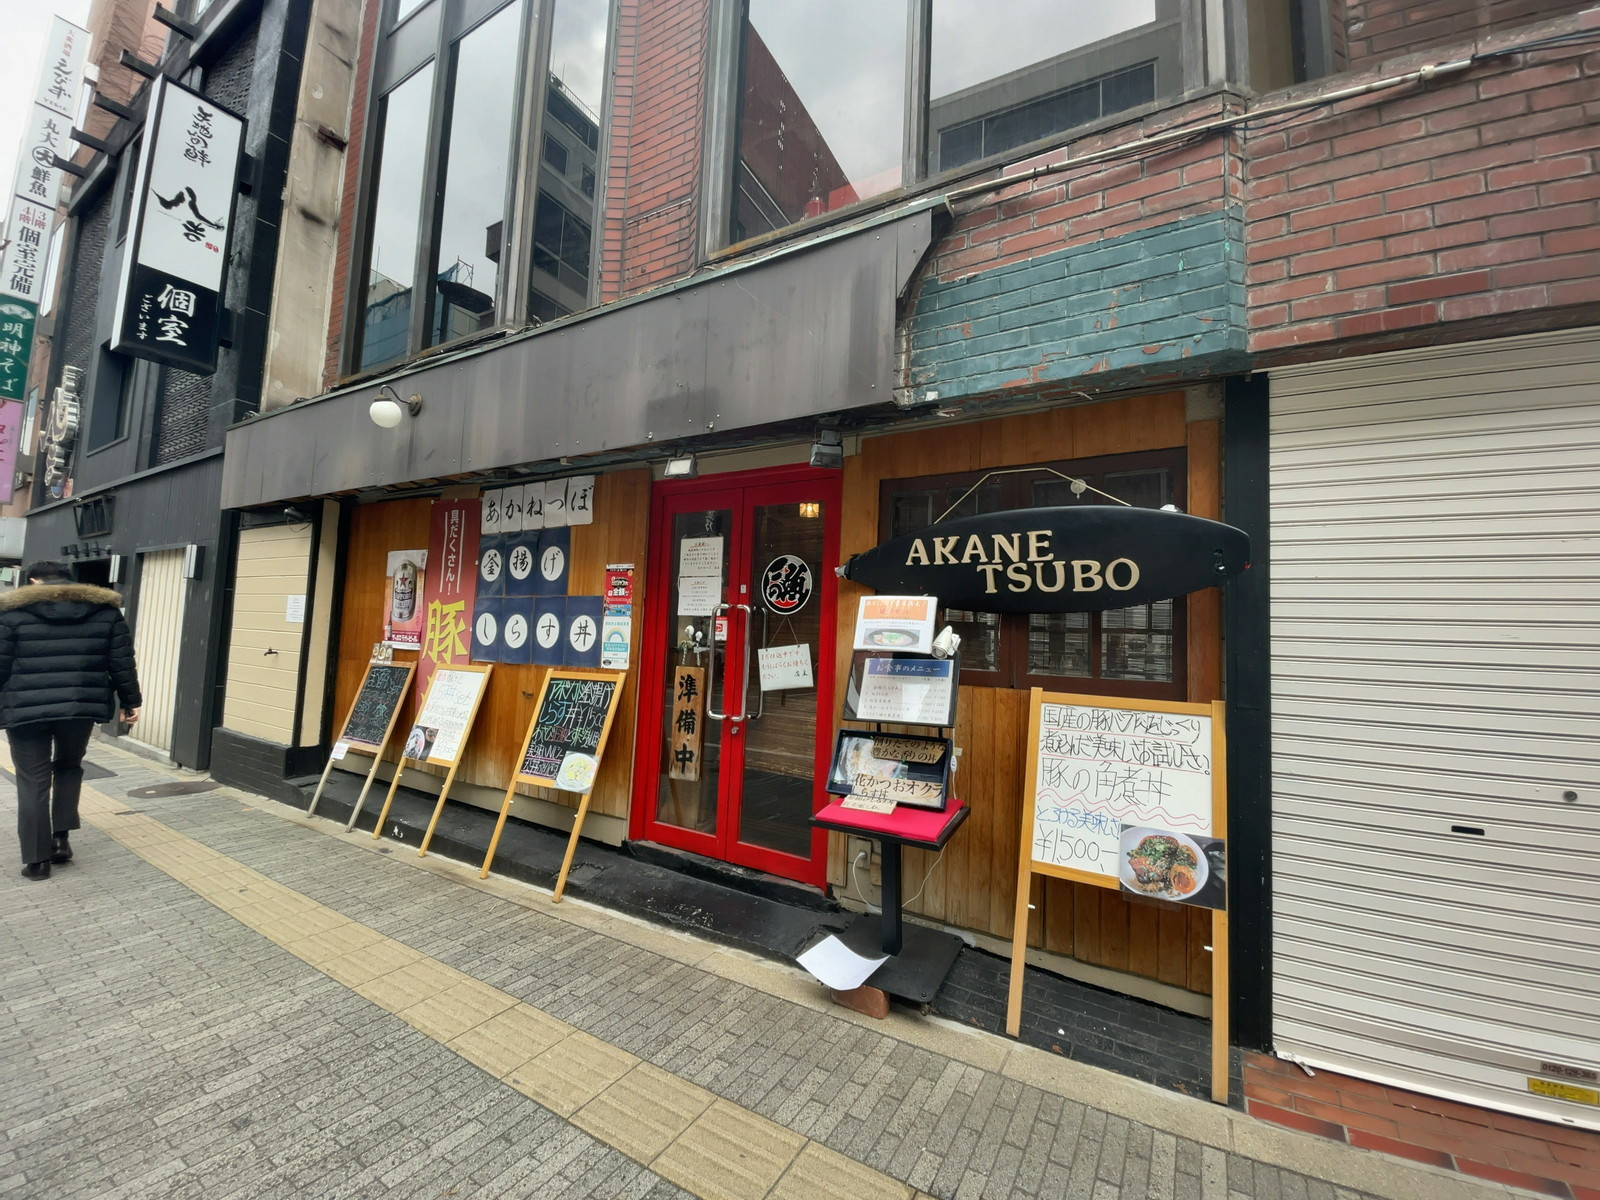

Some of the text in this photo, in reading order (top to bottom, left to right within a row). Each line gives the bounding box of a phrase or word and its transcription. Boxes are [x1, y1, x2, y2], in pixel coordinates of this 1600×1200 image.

[10, 225, 41, 295] 個室完備
[155, 283, 197, 346] 個室
[0, 321, 24, 392] 明神そば
[485, 486, 594, 524] あかねつぼ
[483, 550, 561, 576] 釜揚げ
[905, 530, 1055, 566] AKANE
[976, 557, 1140, 594] TSUBO
[483, 618, 593, 648] しらす丼
[877, 662, 941, 673] お食事のメニュー
[675, 674, 698, 774] 準備中
[854, 773, 943, 798] 花かつおオクラ
[1041, 757, 1173, 806] 豚の角煮丼
